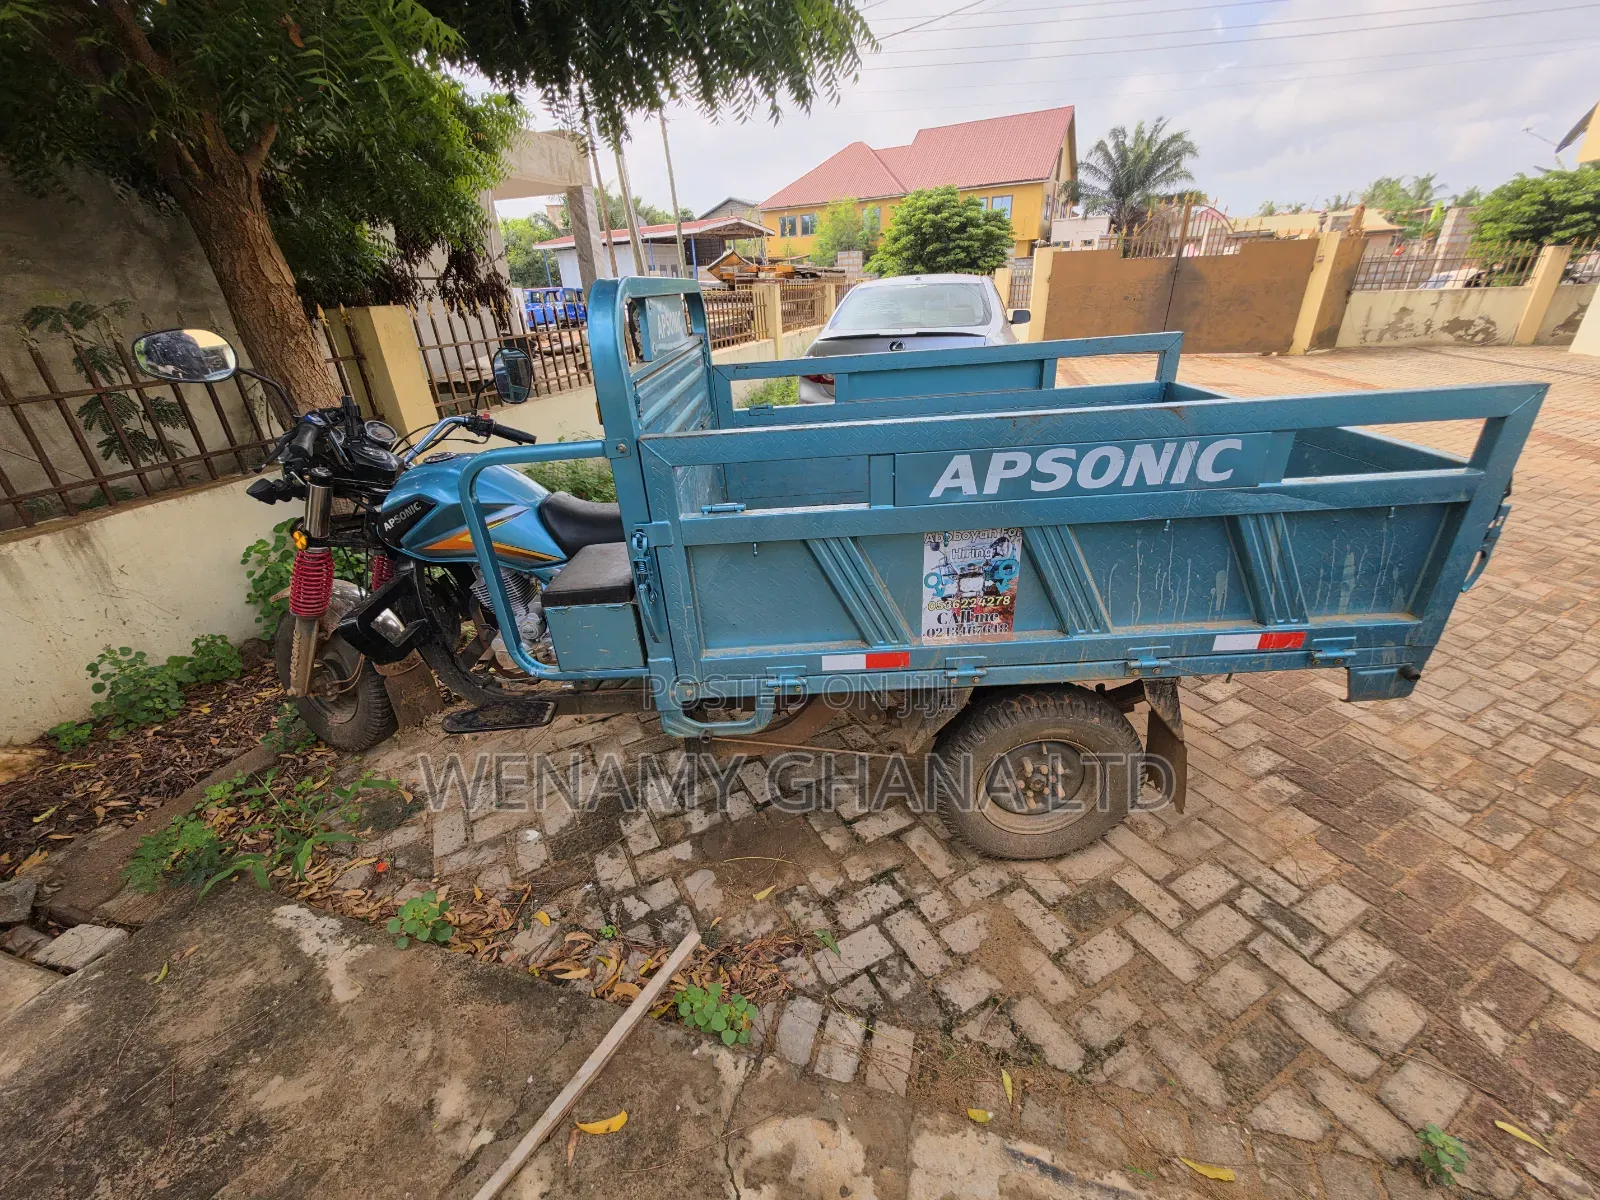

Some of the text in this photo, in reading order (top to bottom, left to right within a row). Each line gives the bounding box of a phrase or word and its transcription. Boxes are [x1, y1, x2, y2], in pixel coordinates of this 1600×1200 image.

[929, 439, 1243, 498] APSONIC
[383, 501, 422, 532] APSONIC
[951, 547, 994, 560] Hiring
[928, 595, 1011, 611] 0536224278
[973, 612, 1000, 623] me
